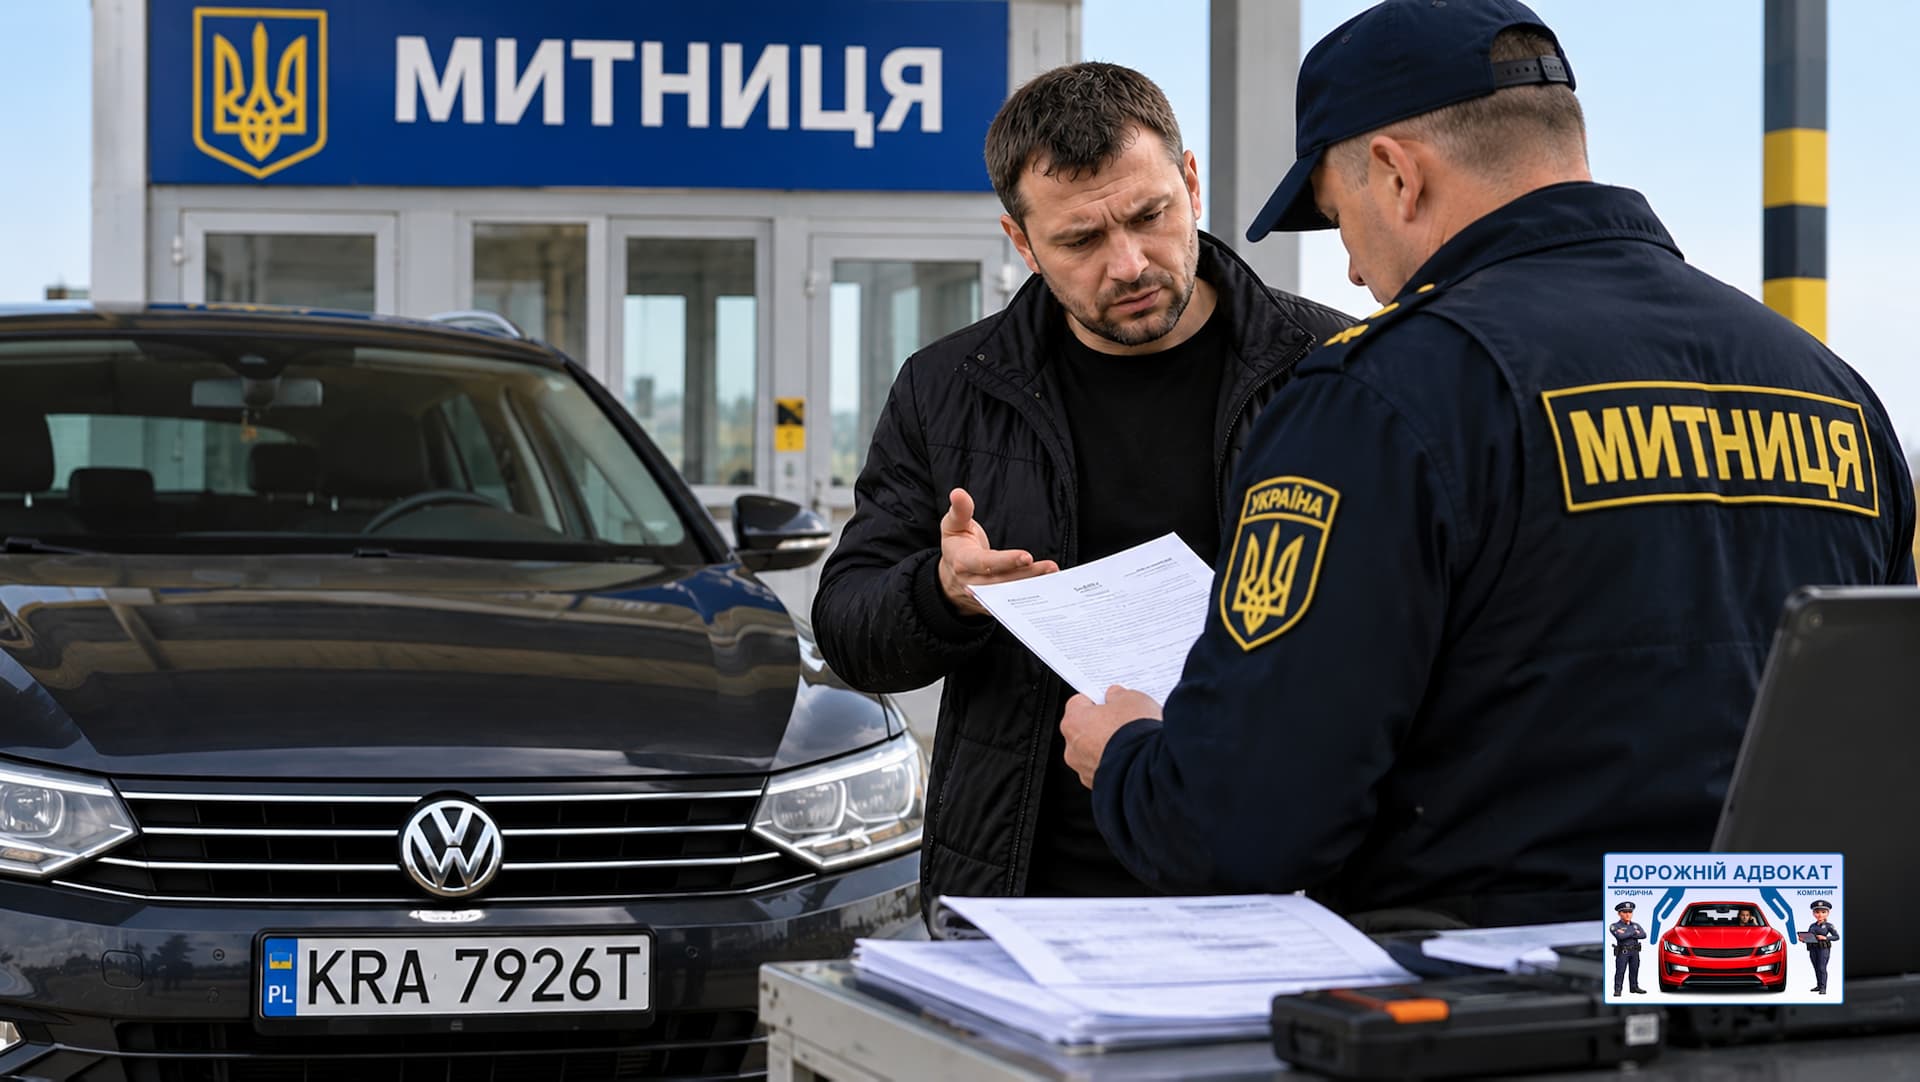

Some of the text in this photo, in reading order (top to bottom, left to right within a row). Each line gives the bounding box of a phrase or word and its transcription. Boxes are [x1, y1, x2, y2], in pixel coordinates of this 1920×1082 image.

[395, 36, 943, 148] МИТНИЦЯ
[1568, 405, 1866, 500] МИТНИЦЯ
[1250, 484, 1324, 519] УКРАЇНА
[268, 985, 293, 1004] PL
[308, 946, 641, 1005] KRA 7926T
